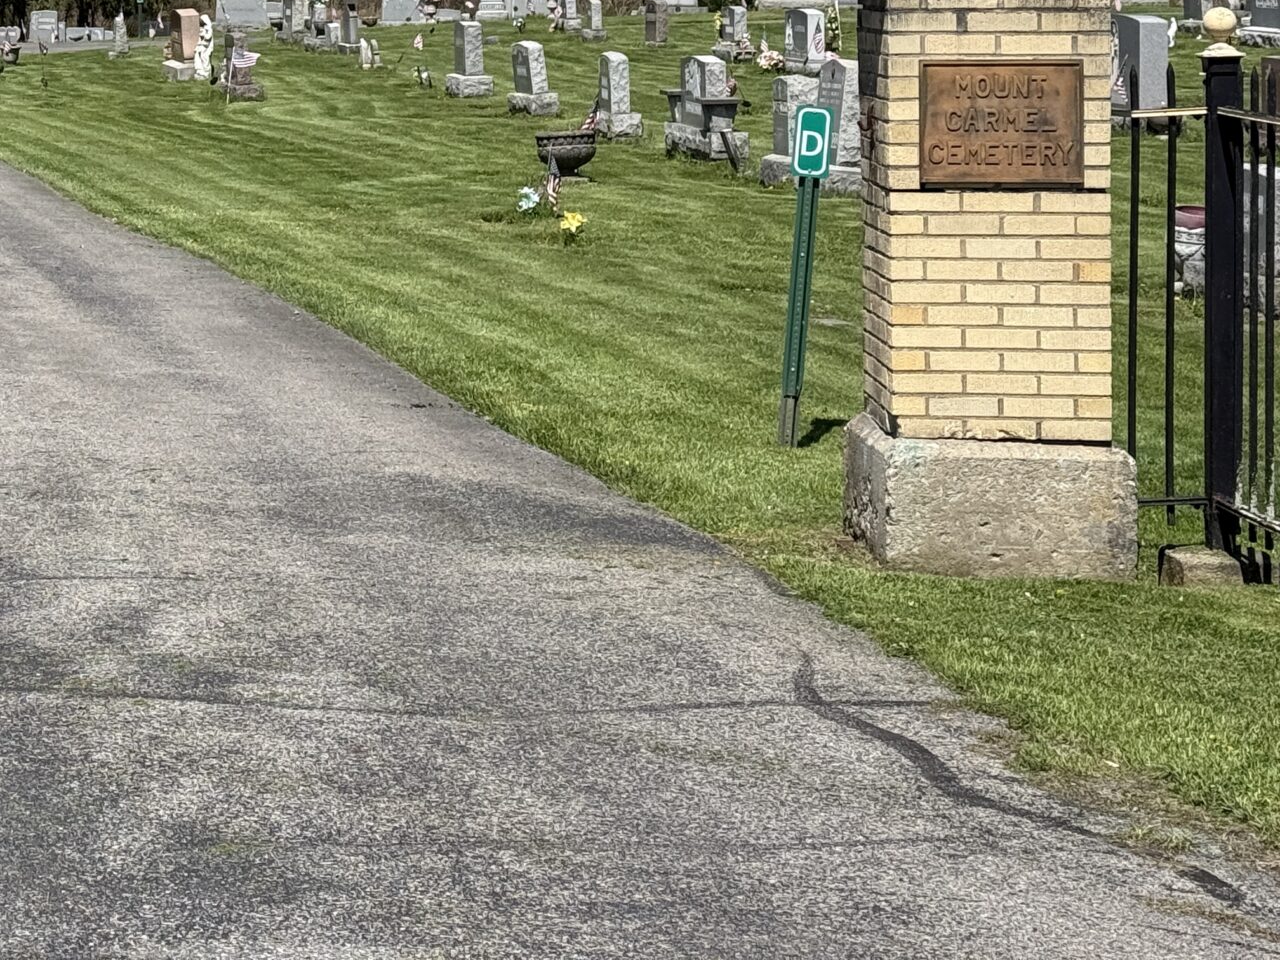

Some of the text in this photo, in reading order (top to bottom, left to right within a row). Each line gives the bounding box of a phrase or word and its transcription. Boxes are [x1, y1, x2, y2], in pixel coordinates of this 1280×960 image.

[955, 75, 1047, 99] MOUNT
[945, 108, 1057, 132] CARMEL
[801, 131, 823, 156] D
[928, 142, 1074, 166] CEMETERY
